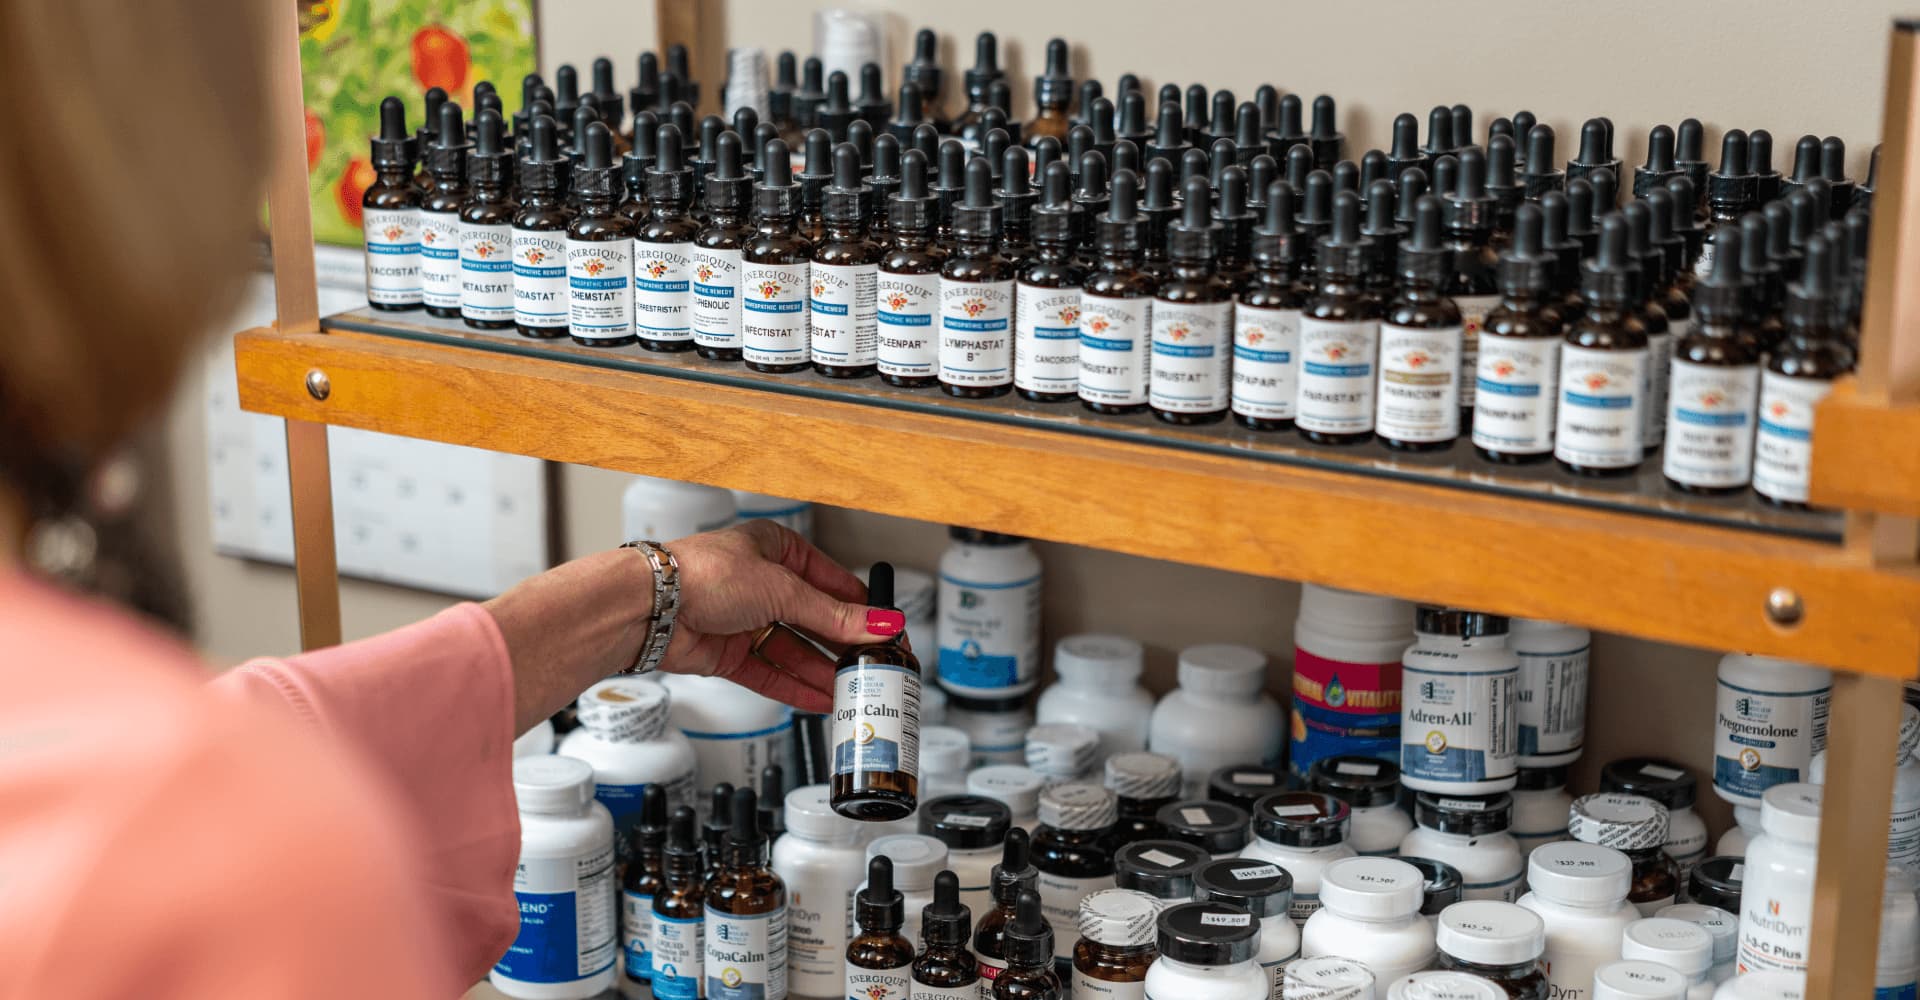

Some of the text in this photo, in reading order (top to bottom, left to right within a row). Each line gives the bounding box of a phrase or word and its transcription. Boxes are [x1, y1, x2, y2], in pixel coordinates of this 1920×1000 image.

[568, 248, 624, 263] ENERGIQUE
[571, 290, 616, 302] CHEMSTAT
[945, 338, 1005, 350] LYMPHASTAT
[837, 703, 899, 721] CopCalm
[1408, 709, 1472, 726] Adren-All
[1719, 713, 1798, 738] Pregnenolone
[1749, 910, 1803, 937] NutriDyn
[706, 943, 765, 963] CopaCalm
[1773, 945, 1802, 960] Plus
[850, 975, 904, 988] ENERGIQUE
